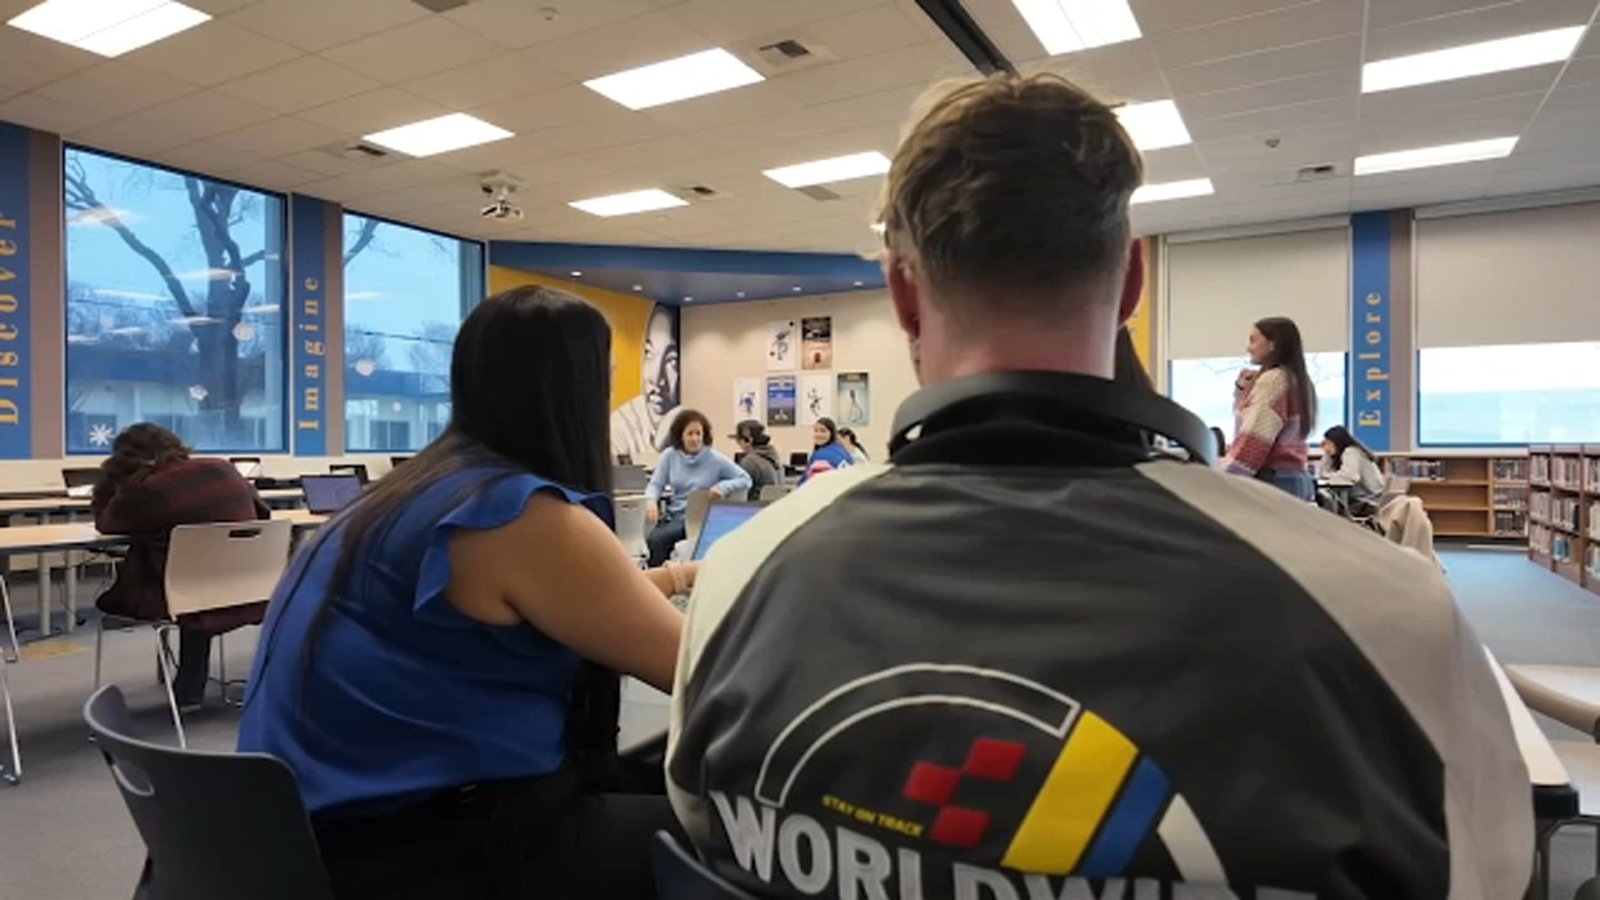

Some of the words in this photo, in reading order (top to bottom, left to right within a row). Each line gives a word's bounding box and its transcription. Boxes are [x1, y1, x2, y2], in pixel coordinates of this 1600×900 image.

[299, 277, 324, 430] Imagine
[1358, 291, 1389, 426] Explore
[708, 790, 1318, 900] WORLD
[822, 794, 856, 817] STAY
[855, 808, 876, 824] ON
[878, 813, 922, 837] TRACK
